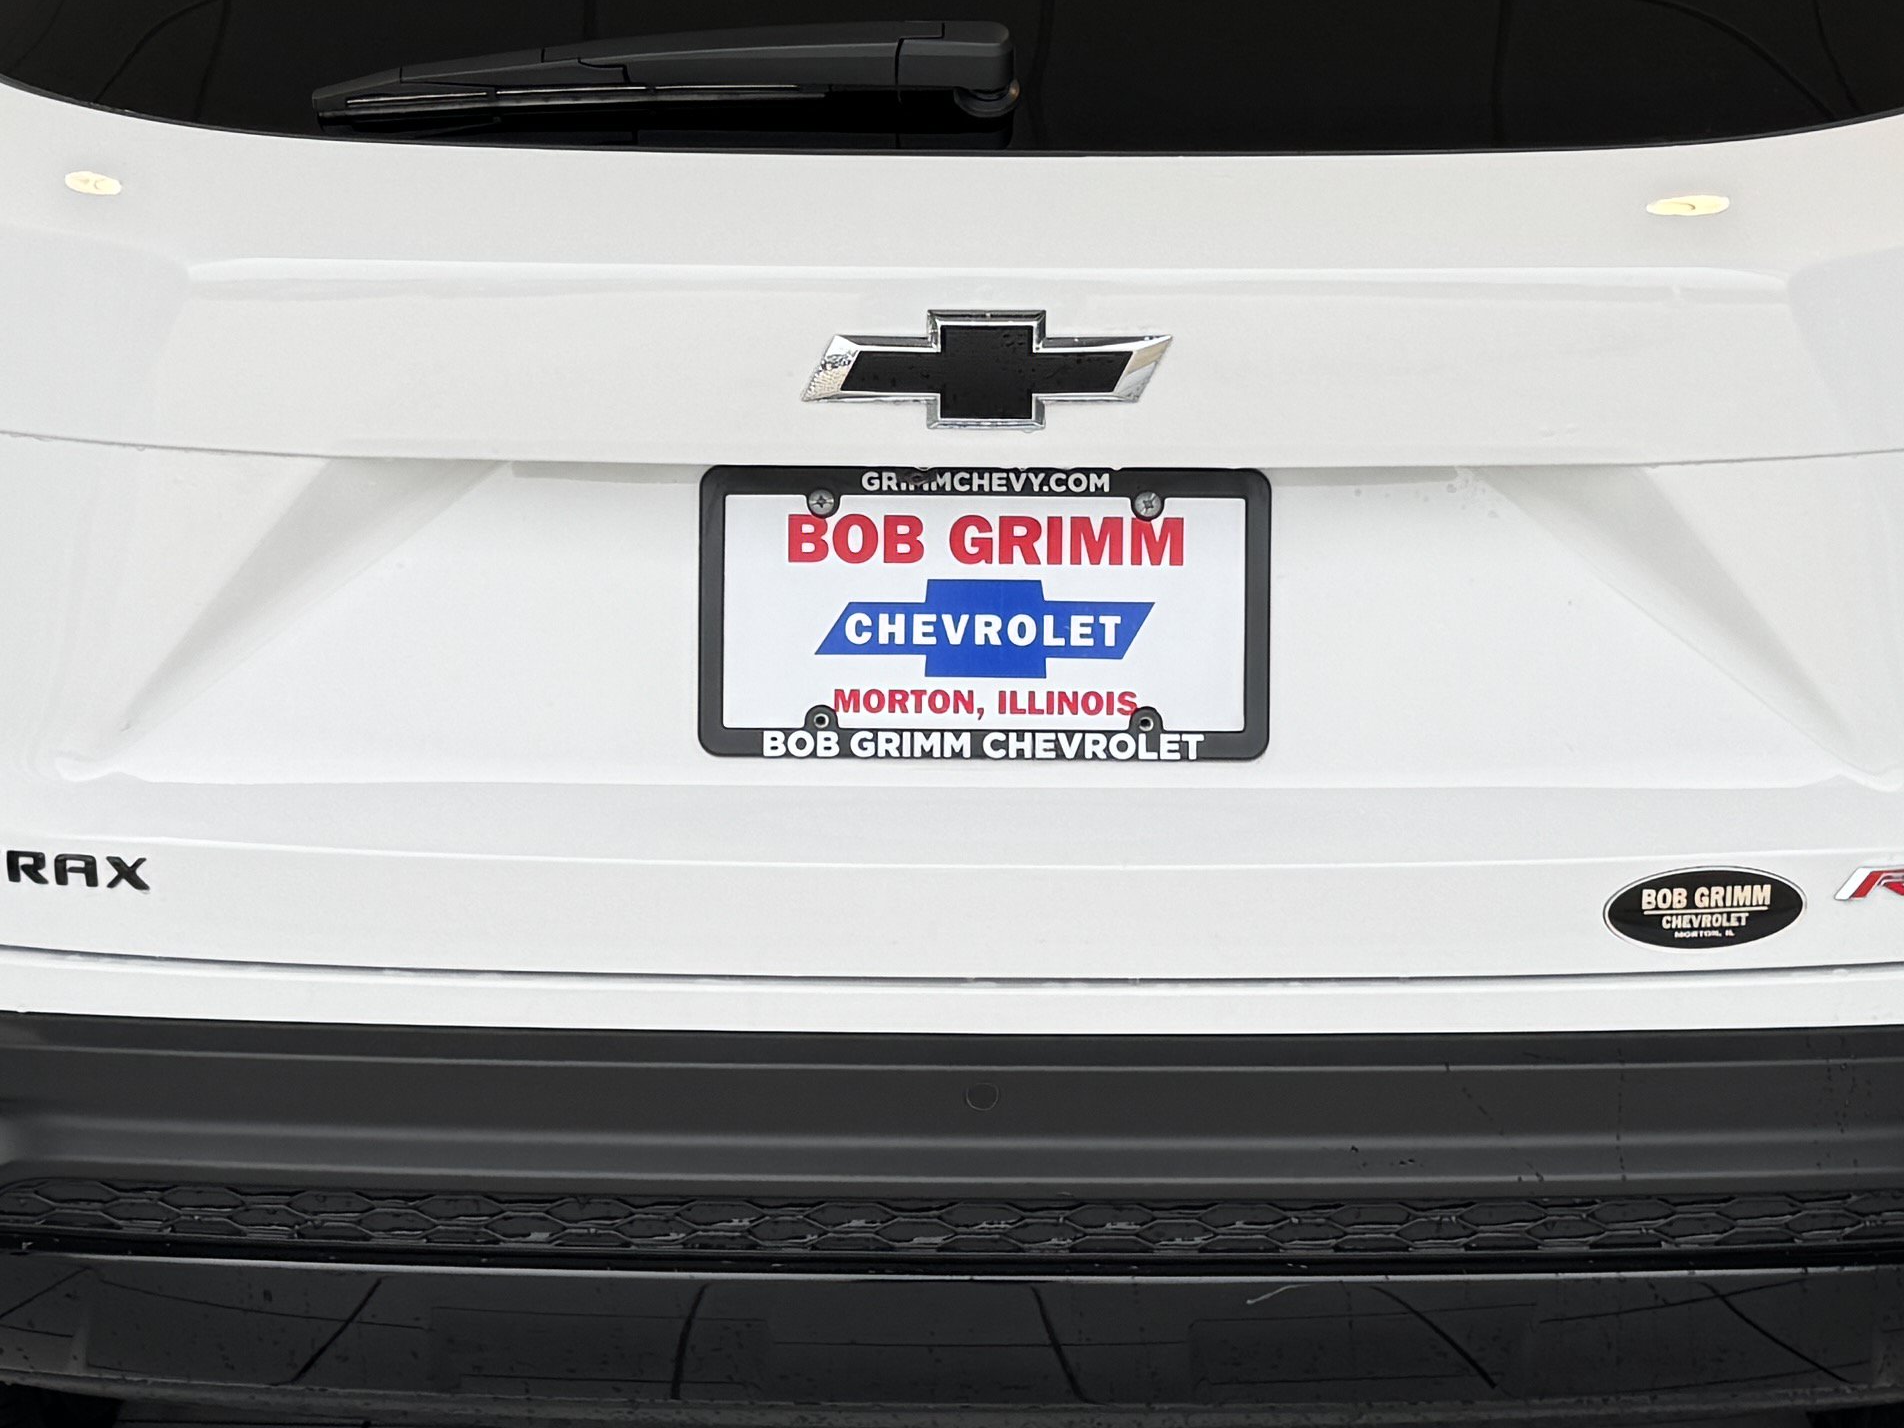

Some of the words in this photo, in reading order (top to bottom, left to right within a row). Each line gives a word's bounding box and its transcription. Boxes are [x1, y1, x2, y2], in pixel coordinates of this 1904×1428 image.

[787, 513, 925, 564] BOB
[949, 514, 1184, 567] GRIMM
[844, 612, 1122, 648] CHEVROLET
[834, 688, 986, 721] MORTON,
[998, 689, 1138, 717] ILLINOIS
[762, 729, 840, 758] BOB
[850, 729, 971, 760] GRIMM
[983, 730, 1205, 762] CHEVROLET
[1641, 888, 1688, 910] BOB
[1694, 884, 1772, 908] GRIMM
[1662, 912, 1749, 929] CHEVROLET
